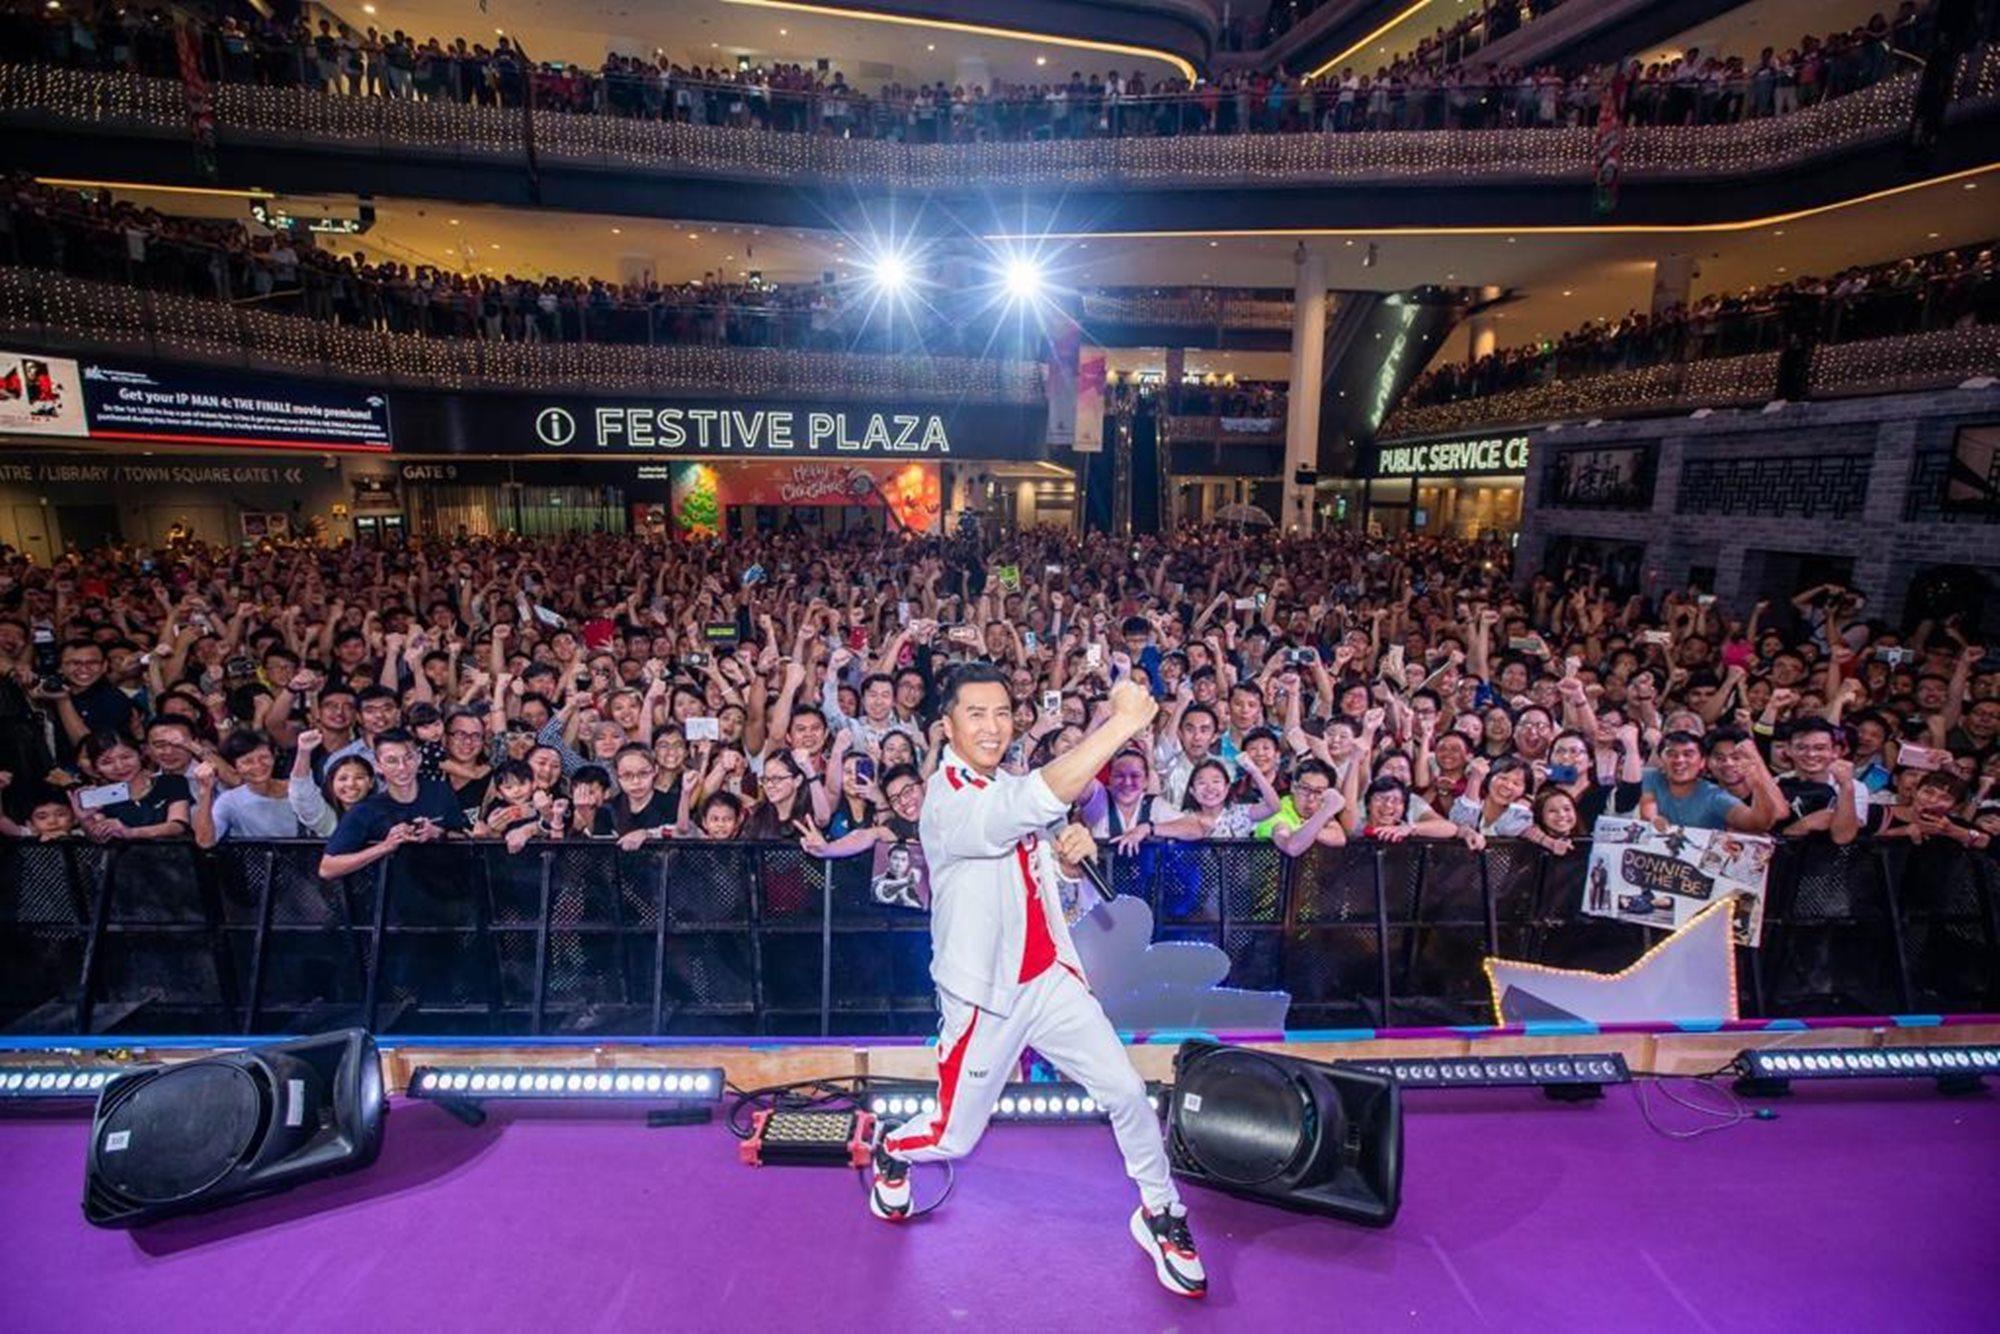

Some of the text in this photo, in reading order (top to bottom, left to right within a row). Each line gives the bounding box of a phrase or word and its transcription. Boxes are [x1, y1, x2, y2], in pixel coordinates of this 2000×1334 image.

[118, 387, 143, 401] Get
[145, 391, 174, 404] your
[175, 392, 190, 405] IP
[191, 394, 219, 407] MAN
[232, 397, 255, 411] THE
[256, 399, 291, 413] FINALE
[292, 404, 322, 416] movie
[595, 407, 794, 449] FESTIVE
[808, 412, 950, 452] PLAZA
[1379, 447, 1428, 473] PUBLIC
[1429, 439, 1502, 471] SERVICE
[47, 465, 108, 481] LIBRARY
[123, 466, 170, 481] TOWN
[170, 466, 232, 484] SQUARE
[233, 467, 271, 483] GATE
[403, 465, 457, 479] GATE 9
[1624, 850, 1694, 877] DONNIE
[1643, 871, 1673, 888] THE
